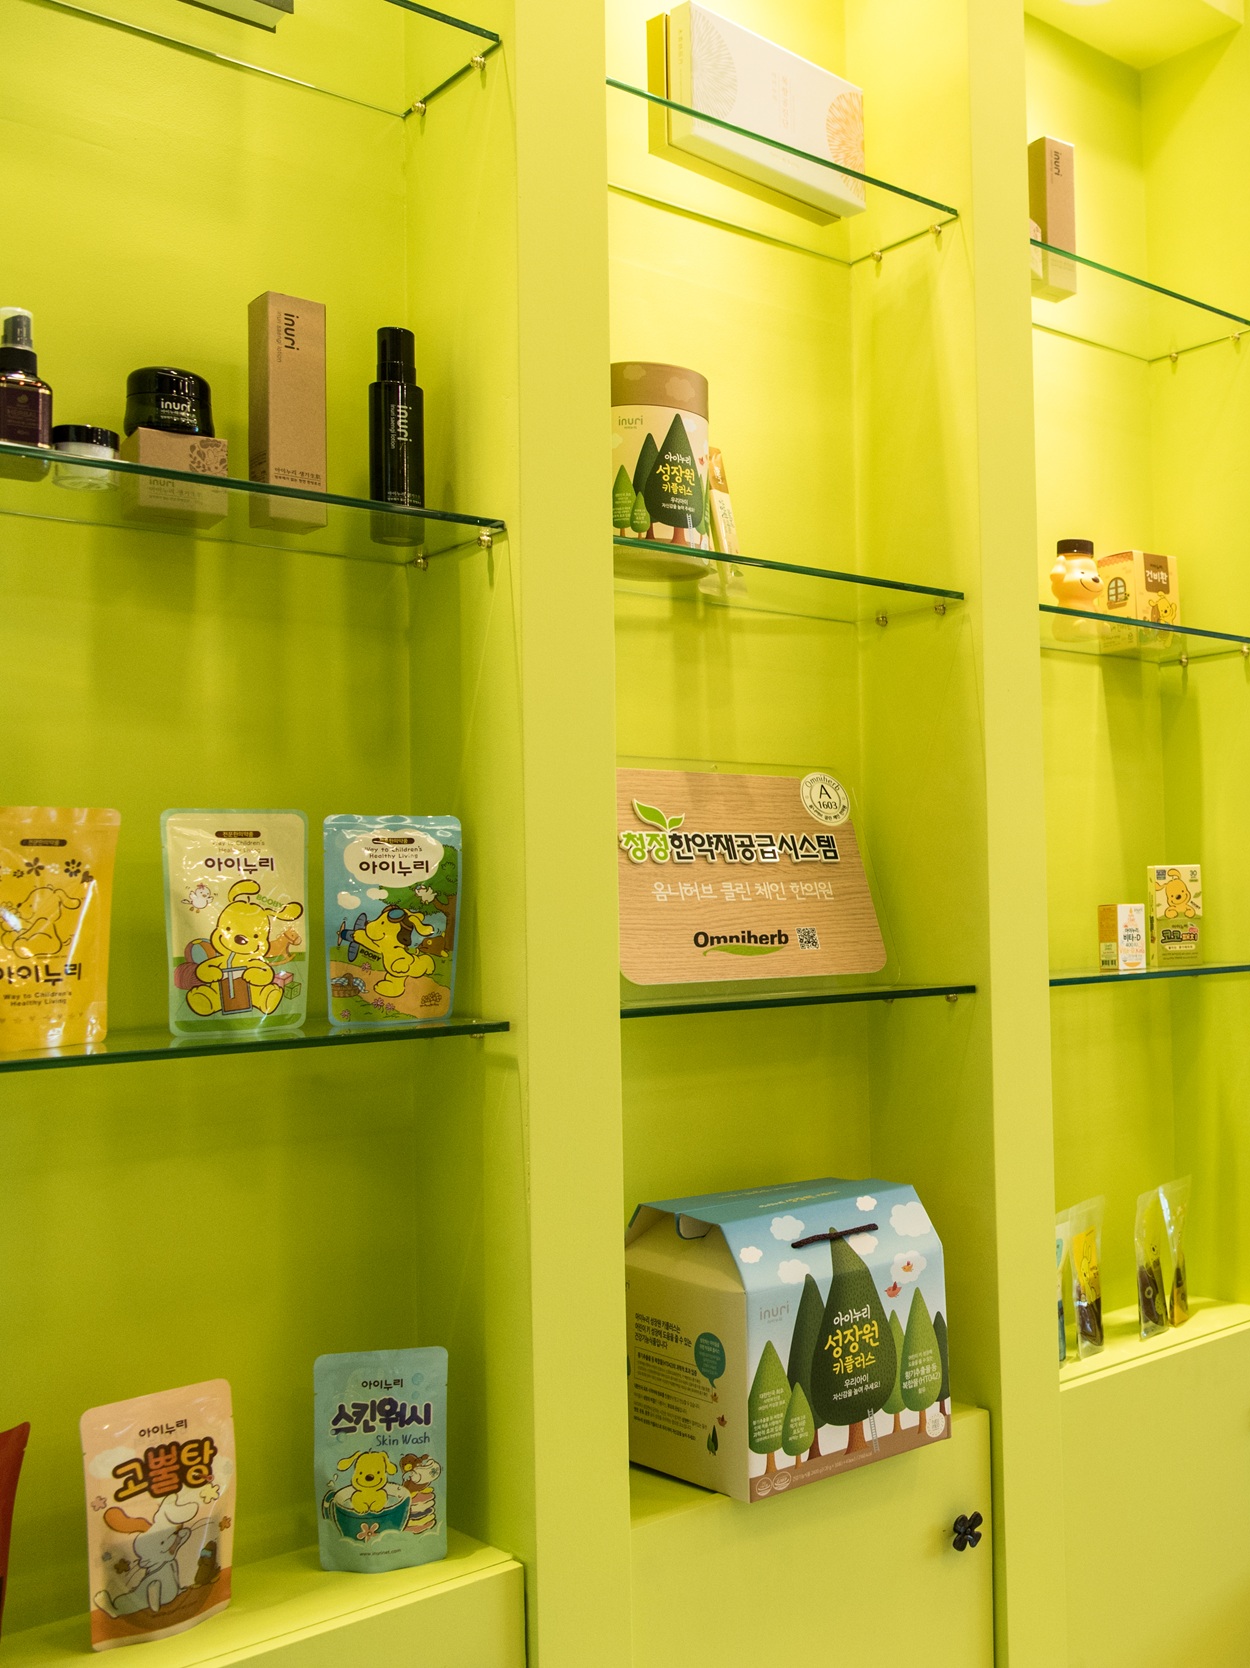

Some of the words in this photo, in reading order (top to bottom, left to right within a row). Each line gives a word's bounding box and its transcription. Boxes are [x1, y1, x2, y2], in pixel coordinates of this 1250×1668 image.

[1054, 151, 1062, 176] inuri
[284, 313, 300, 350] inuri
[160, 398, 191, 412] inuri
[397, 405, 412, 442] inuri
[618, 416, 644, 426] inuri
[664, 452, 692, 466] 아이누리
[656, 464, 695, 486] 성장원
[662, 482, 693, 496] 키플러스
[804, 775, 840, 791] Omniherb
[819, 784, 832, 800] A
[818, 801, 838, 810] 1603
[620, 831, 840, 862] 청정한약재공급시스템
[204, 858, 274, 874] 아이누리
[359, 860, 428, 877] 아이누리
[652, 881, 718, 902] 옴니허브
[720, 882, 752, 902] 클린
[755, 881, 787, 901] 체인
[790, 881, 835, 901] 한의원
[693, 930, 790, 948] Omniherb
[360, 949, 381, 961] BOOBY
[0, 963, 82, 986] 아이누리
[34, 990, 72, 998] Children's
[760, 1301, 789, 1320] inuri
[833, 1304, 870, 1326] 아이누리
[824, 1320, 880, 1358] 성장원
[832, 1352, 876, 1374] 키플러스
[362, 1378, 403, 1390] 아이누리
[844, 1373, 869, 1388] 우리아이
[832, 1388, 852, 1401] 자신감을
[853, 1386, 864, 1395] 높여
[864, 1380, 880, 1391] 주세요!
[331, 1397, 432, 1436] 스킨워시
[138, 1418, 188, 1438] 아이누리
[376, 1434, 399, 1446] Skin
[402, 1432, 430, 1445] Wash
[112, 1437, 218, 1502] 고뿔탕
